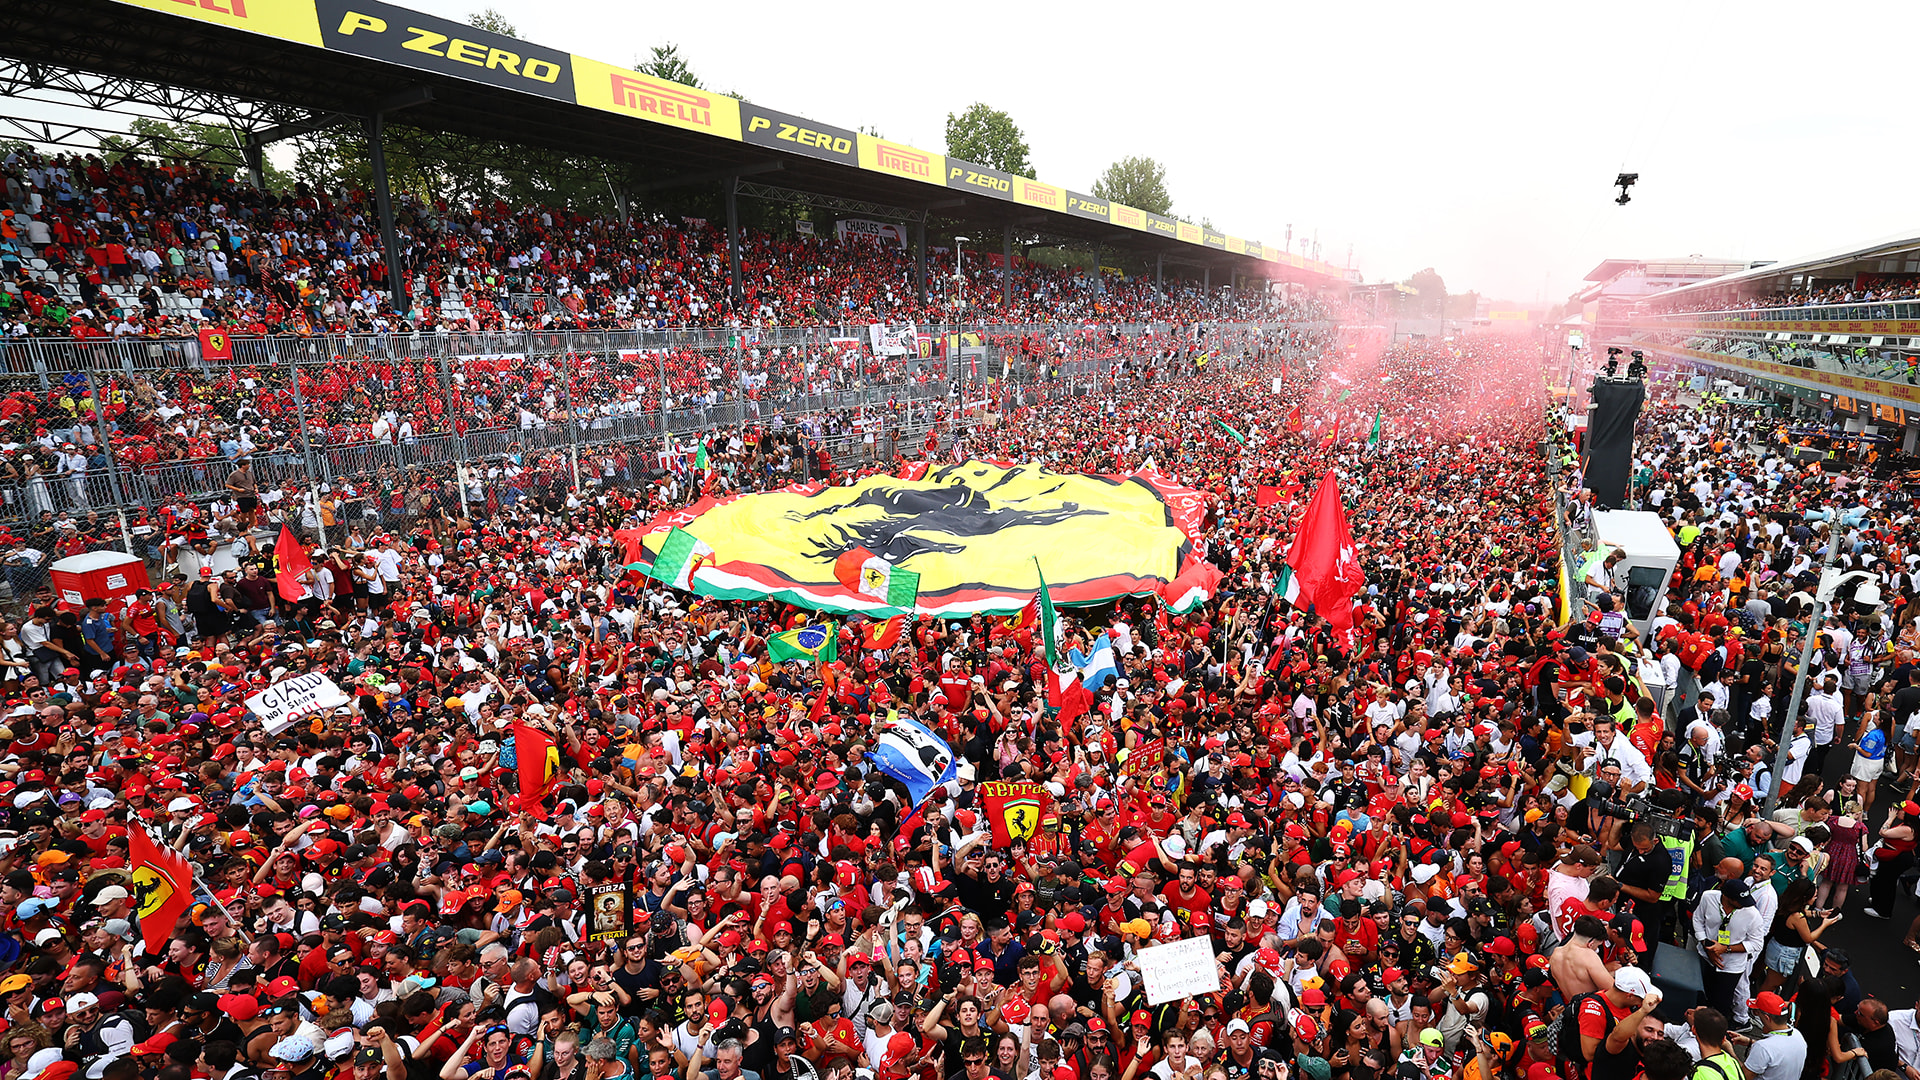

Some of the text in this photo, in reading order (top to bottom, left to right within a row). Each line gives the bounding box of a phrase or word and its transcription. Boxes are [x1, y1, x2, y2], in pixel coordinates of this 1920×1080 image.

[337, 10, 562, 84] P ZERO
[610, 72, 712, 127] PIRELLI
[748, 115, 852, 155] P ZERO
[876, 143, 930, 177] PIRELLI
[950, 167, 1010, 192] P ZERO
[1024, 182, 1056, 206] PIRELLI
[1068, 197, 1108, 216] P ZERO
[845, 220, 880, 234] CHARLES
[1117, 207, 1140, 226] PIRELLI
[1147, 218, 1176, 233] P ZERO
[262, 673, 323, 708] GIALLU
[266, 692, 316, 721] NOI SIAMO
[592, 883, 626, 895] FORZA
